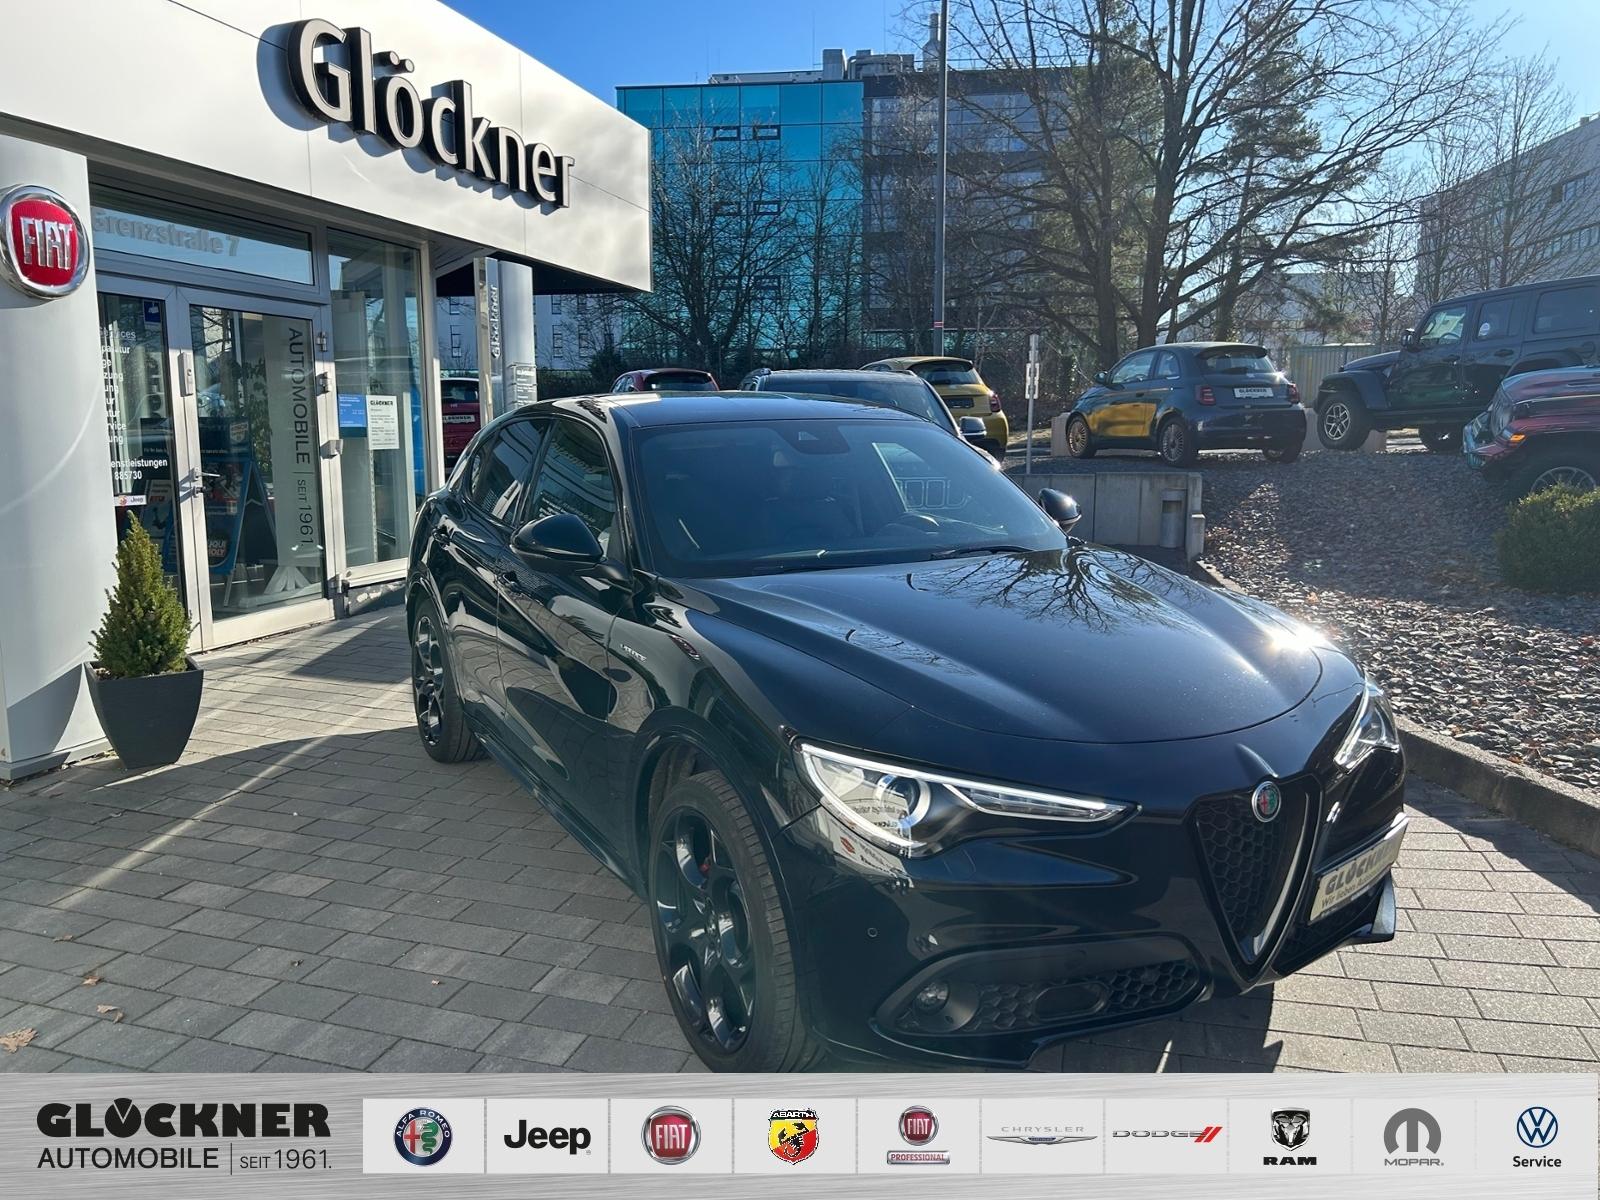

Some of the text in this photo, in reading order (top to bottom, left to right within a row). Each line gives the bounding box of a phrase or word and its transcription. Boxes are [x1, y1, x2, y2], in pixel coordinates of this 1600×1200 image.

[288, 18, 576, 208] Glöckner
[20, 215, 74, 271] FIAT
[225, 234, 241, 257] 7
[288, 326, 311, 465] AUTOMOBILE
[298, 479, 307, 502] SEIT
